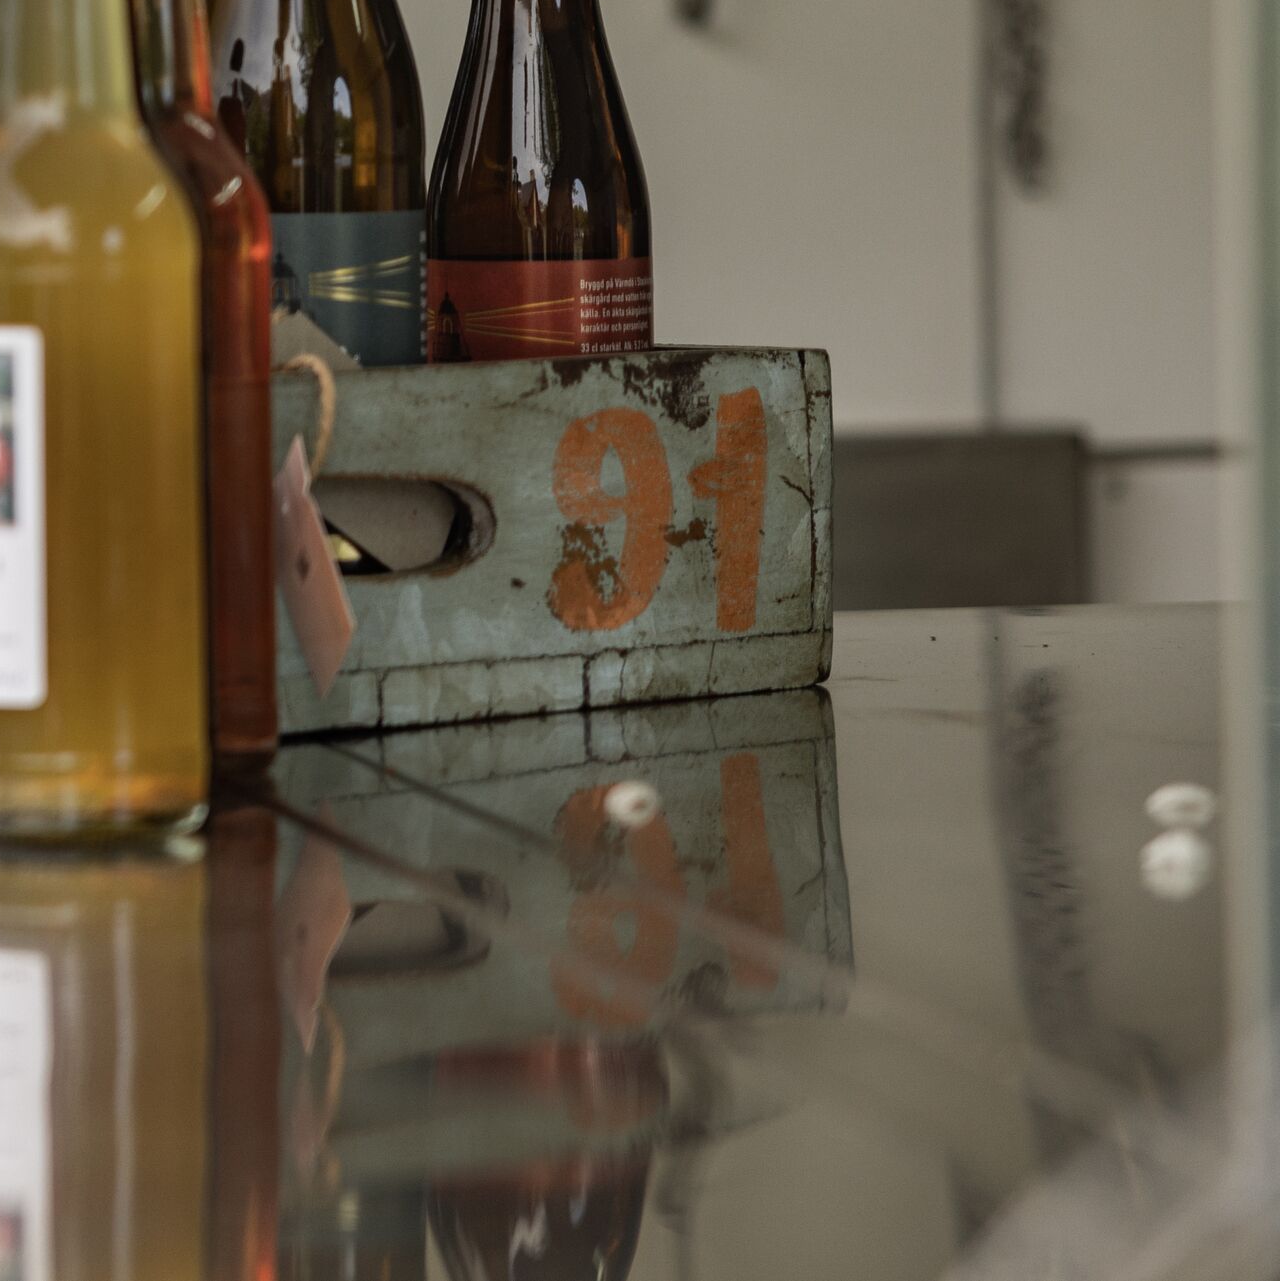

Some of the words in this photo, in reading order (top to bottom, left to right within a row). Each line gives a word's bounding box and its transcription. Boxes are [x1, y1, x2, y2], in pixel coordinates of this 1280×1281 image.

[580, 278, 604, 291] Bryggd
[606, 277, 614, 290] på
[580, 293, 611, 305] skärgård
[580, 322, 610, 333] karaktär
[580, 342, 590, 353] 33
[591, 341, 598, 352] cl
[546, 387, 767, 631] 91
